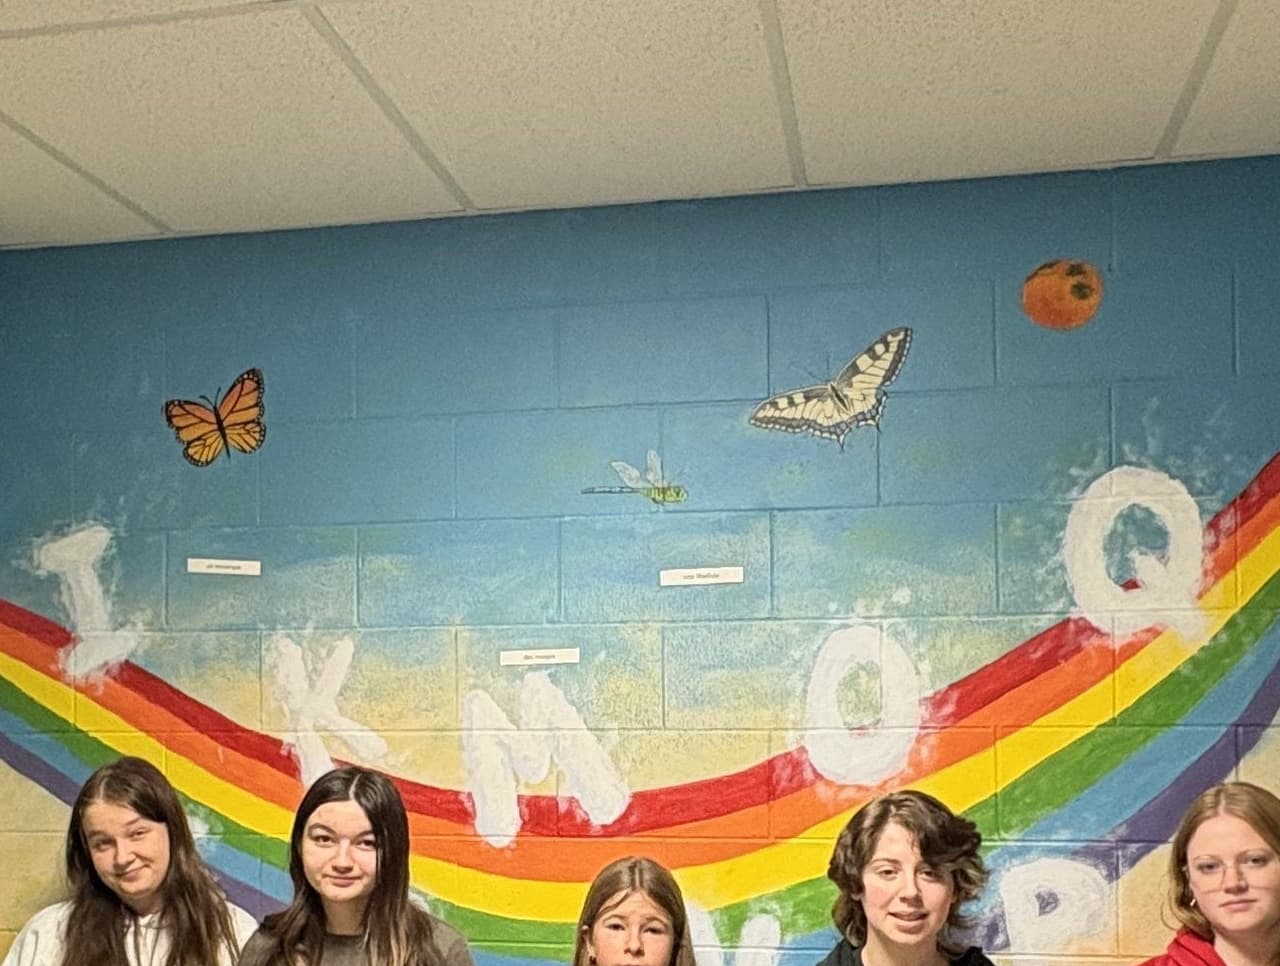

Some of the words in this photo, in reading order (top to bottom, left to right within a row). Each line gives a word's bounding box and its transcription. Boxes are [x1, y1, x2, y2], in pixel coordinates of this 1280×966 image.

[36, 523, 136, 678] I
[273, 632, 388, 790] K
[460, 672, 632, 849] M
[805, 626, 921, 785] O
[1063, 464, 1208, 640] Q
